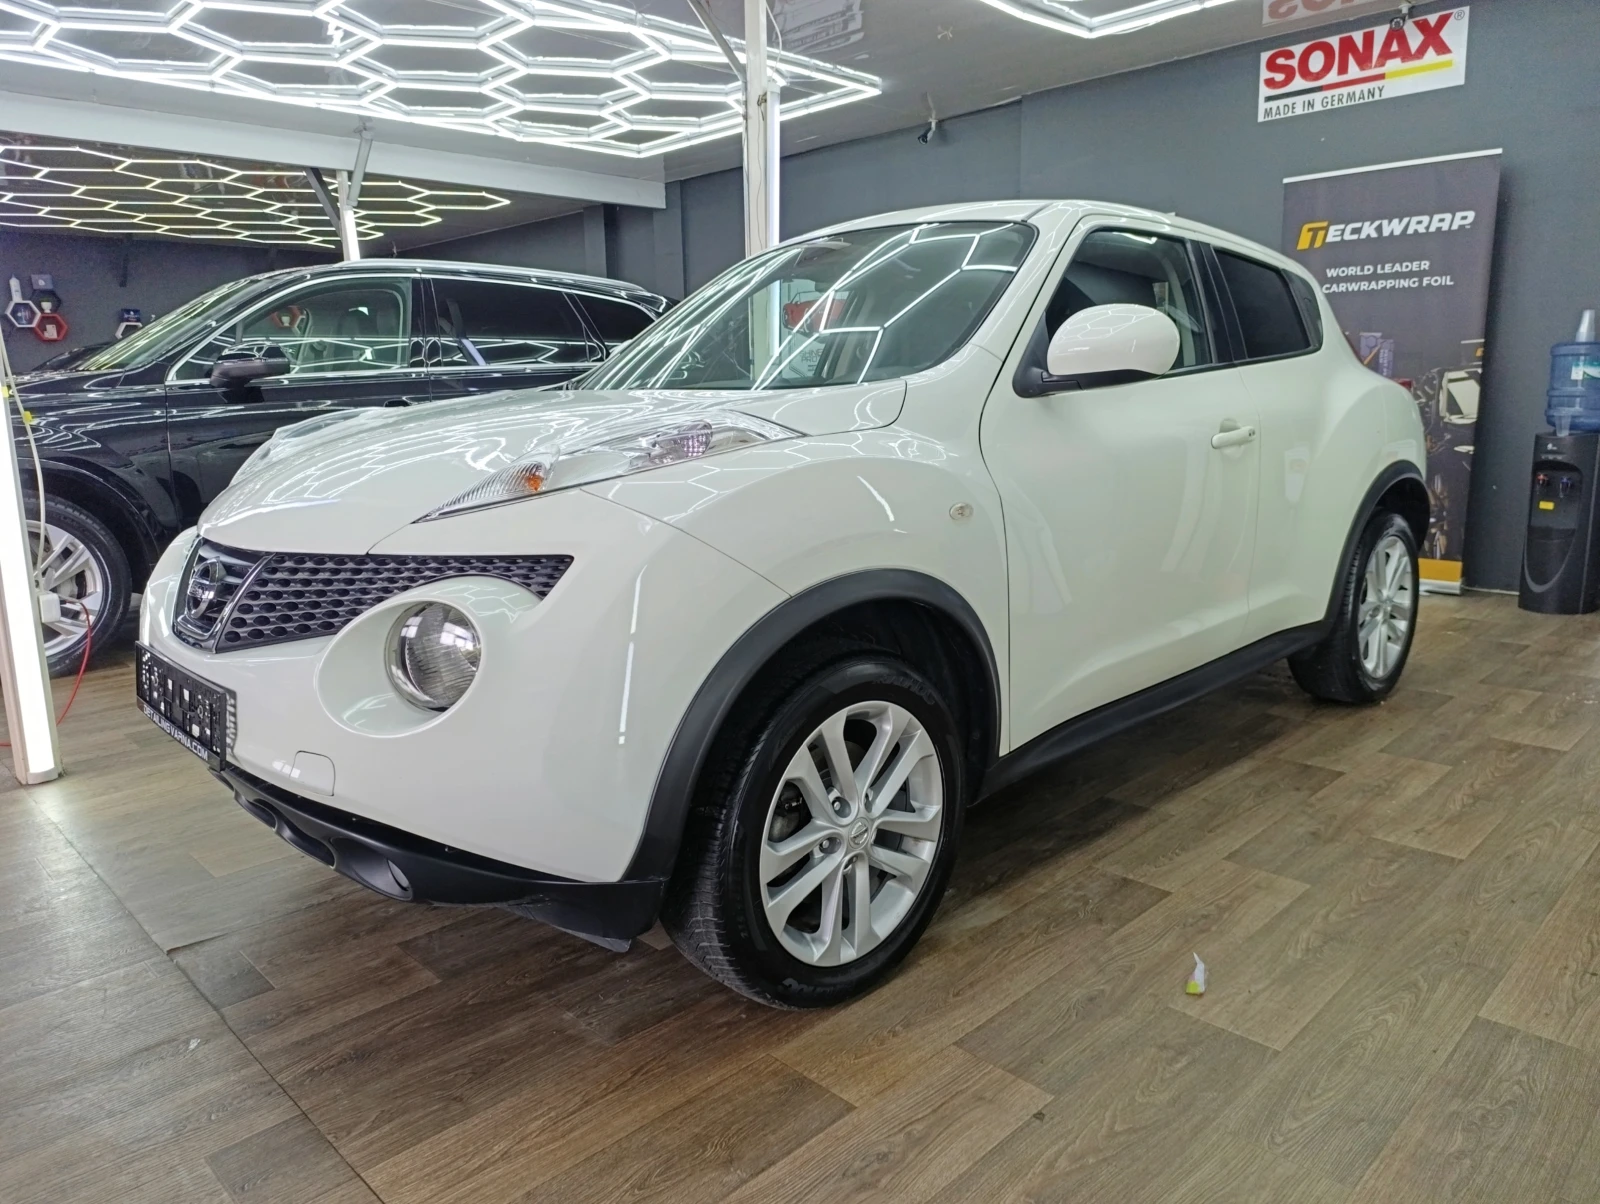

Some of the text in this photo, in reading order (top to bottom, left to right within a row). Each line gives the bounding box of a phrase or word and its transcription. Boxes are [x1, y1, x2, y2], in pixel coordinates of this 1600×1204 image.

[1263, 12, 1455, 90] SONAX
[1263, 85, 1386, 120] MADE IN GERMANY
[1326, 260, 1430, 278] WORLD LEADER
[1322, 275, 1455, 294] CARWRAPPING FOIL
